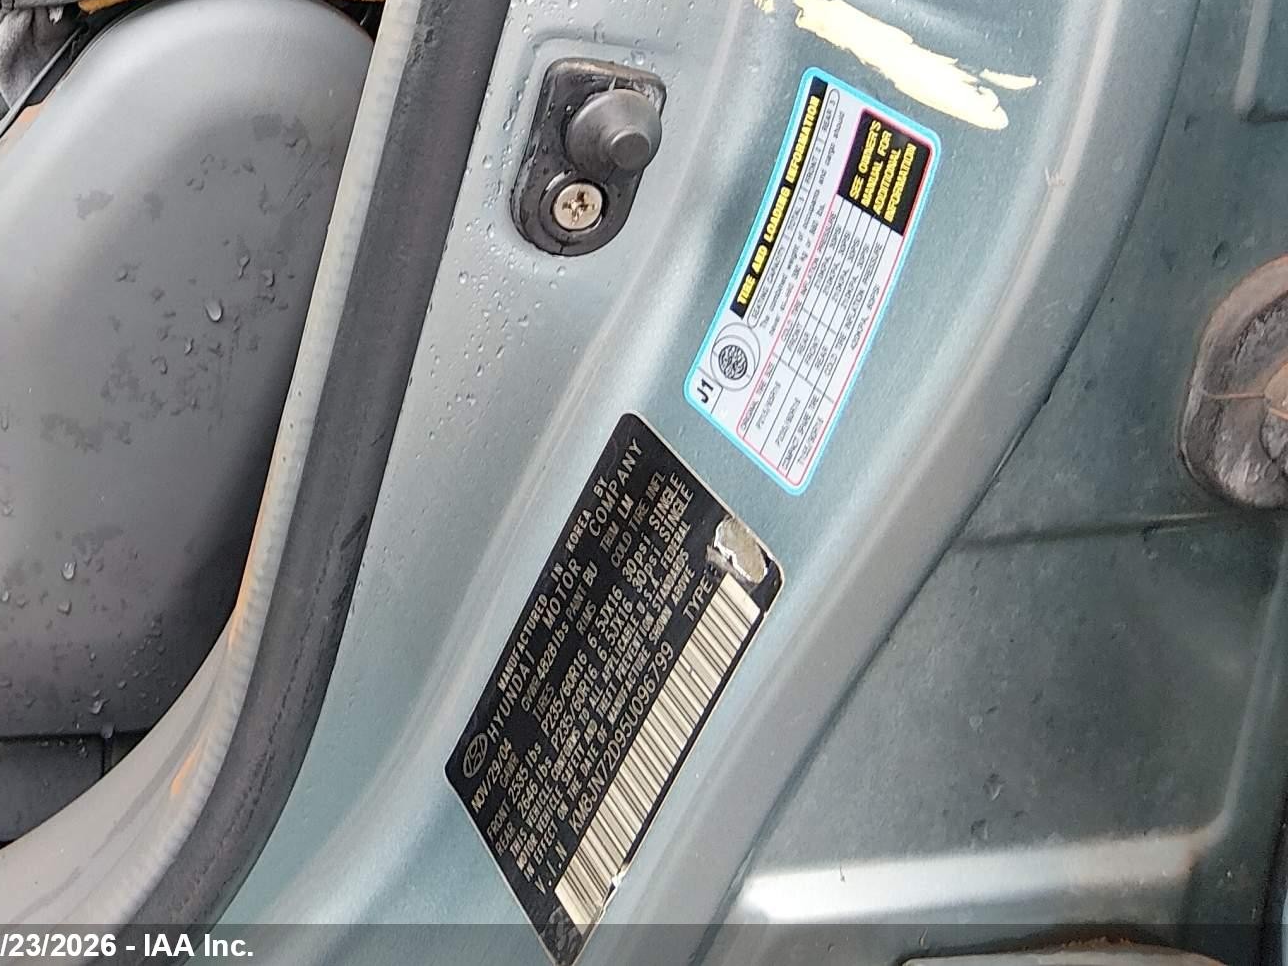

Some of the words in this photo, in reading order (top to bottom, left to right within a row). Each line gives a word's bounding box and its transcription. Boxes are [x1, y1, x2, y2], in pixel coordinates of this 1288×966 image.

[736, 272, 756, 308] TIRE
[750, 243, 768, 275] AND
[762, 184, 791, 243] LOADING
[785, 93, 820, 184] INFORMATION
[848, 173, 864, 200] SEE
[857, 119, 881, 174] OWNER'S
[859, 157, 883, 208] MANUAL
[876, 129, 893, 156] FOR
[871, 144, 902, 215] ADDITIONAL
[883, 142, 917, 222] INFORMATION
[694, 376, 714, 405] J1
[470, 735, 513, 815] NOV/29/04
[581, 559, 599, 587] BU
[616, 492, 634, 520] LM
[486, 648, 535, 744] HYUNDAI
[541, 556, 582, 630] MOTOR
[587, 437, 643, 539] COMPANY
[486, 797, 511, 844] FRONT
[540, 647, 588, 738] P235/60R16
[585, 582, 624, 650] 6.5JX16
[620, 530, 653, 585] 30psi
[647, 471, 683, 532] SINGLE
[494, 819, 516, 858] REAR
[550, 660, 599, 752] P235/60R16
[594, 594, 635, 663] 6.5JX16
[630, 542, 664, 597] 30psi
[657, 482, 694, 543] SINGLE
[496, 591, 548, 693] MANUFACTURED
[550, 560, 564, 583] IN
[564, 505, 592, 554] KOREA
[592, 474, 608, 498] BY
[509, 825, 528, 859] THIS
[524, 778, 553, 829] VEHICLE
[549, 724, 582, 783] CONFORMS
[578, 705, 591, 727] TO
[587, 682, 603, 709] ALL
[599, 613, 640, 683] APPLICABLE
[659, 516, 691, 570] FEDERAL
[531, 680, 556, 723] TIRES
[609, 528, 633, 569] COLD
[627, 498, 649, 534] TIRE
[515, 830, 538, 871] MOTOR
[534, 783, 564, 836] VEHICLE
[560, 742, 585, 787] SAFETY
[581, 716, 599, 746] AND
[595, 680, 618, 719] THEFT
[614, 610, 655, 681] PREVENTION
[650, 545, 690, 613] STANDARDS
[522, 861, 535, 883] IN
[532, 817, 559, 865] EFFECT
[555, 798, 569, 822] ON
[566, 774, 582, 802] THE
[578, 742, 600, 778] DATE
[595, 722, 610, 745] OF
[605, 643, 651, 726] MANUFACTURE
[647, 603, 673, 646] SHOWN
[668, 562, 696, 607] ABOVE
[567, 638, 676, 837] KM8JN72D95U096799
